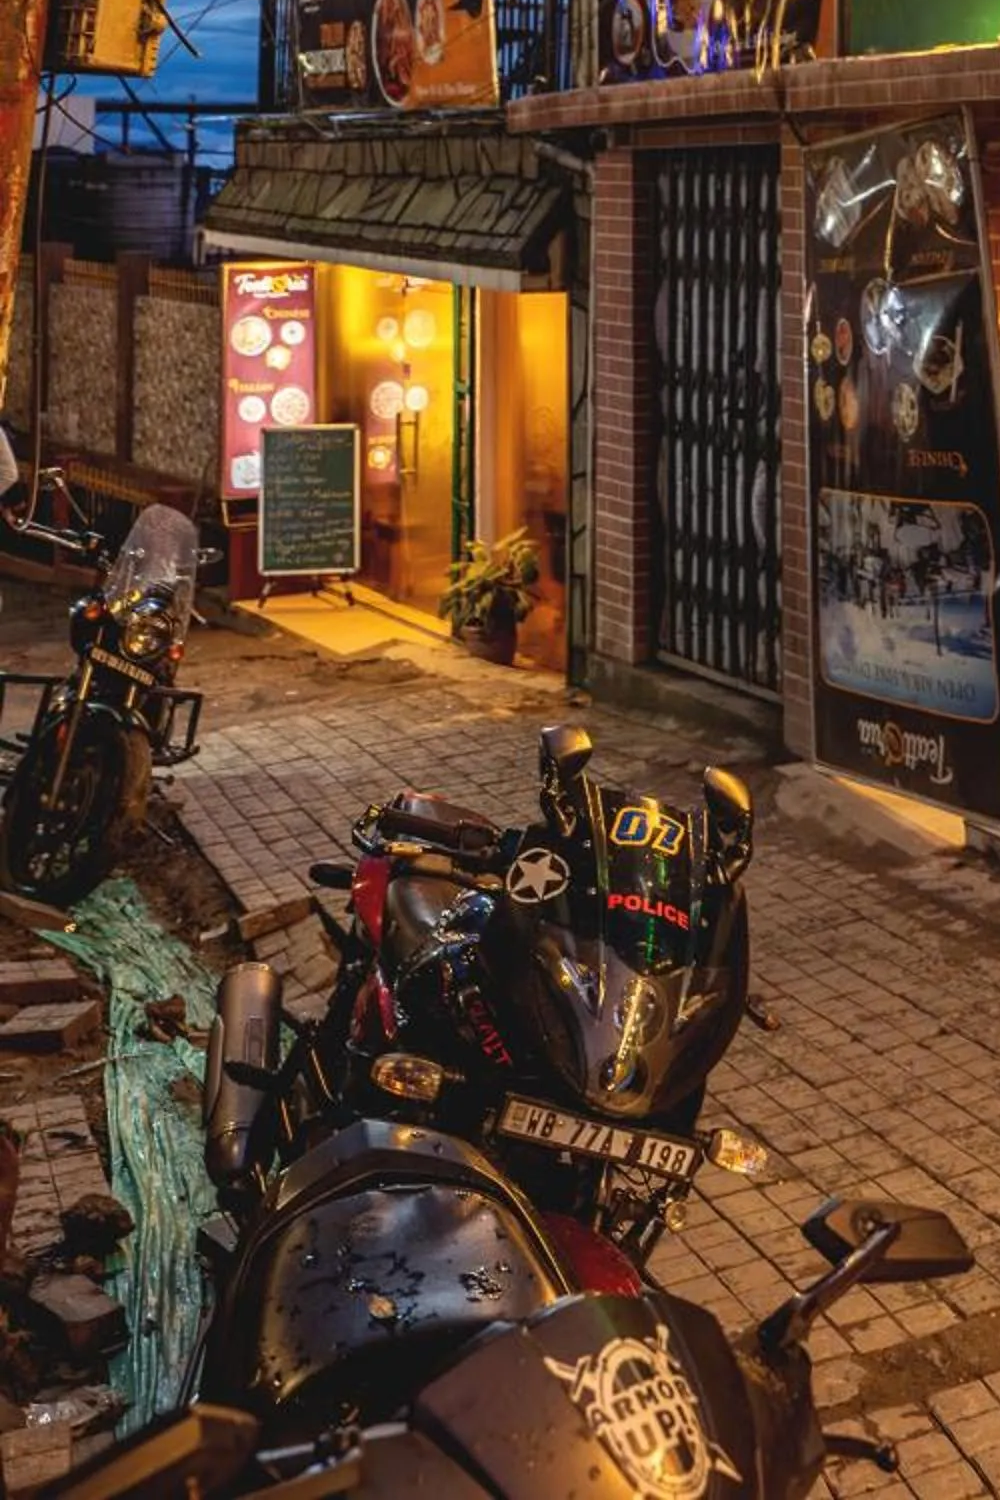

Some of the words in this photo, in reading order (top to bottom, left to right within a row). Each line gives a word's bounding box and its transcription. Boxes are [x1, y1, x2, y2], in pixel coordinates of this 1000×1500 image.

[607, 894, 689, 930] POLICE
[526, 1109, 557, 1138] WB
[590, 1379, 692, 1424] ARMOR
[625, 1404, 693, 1458] UP!
